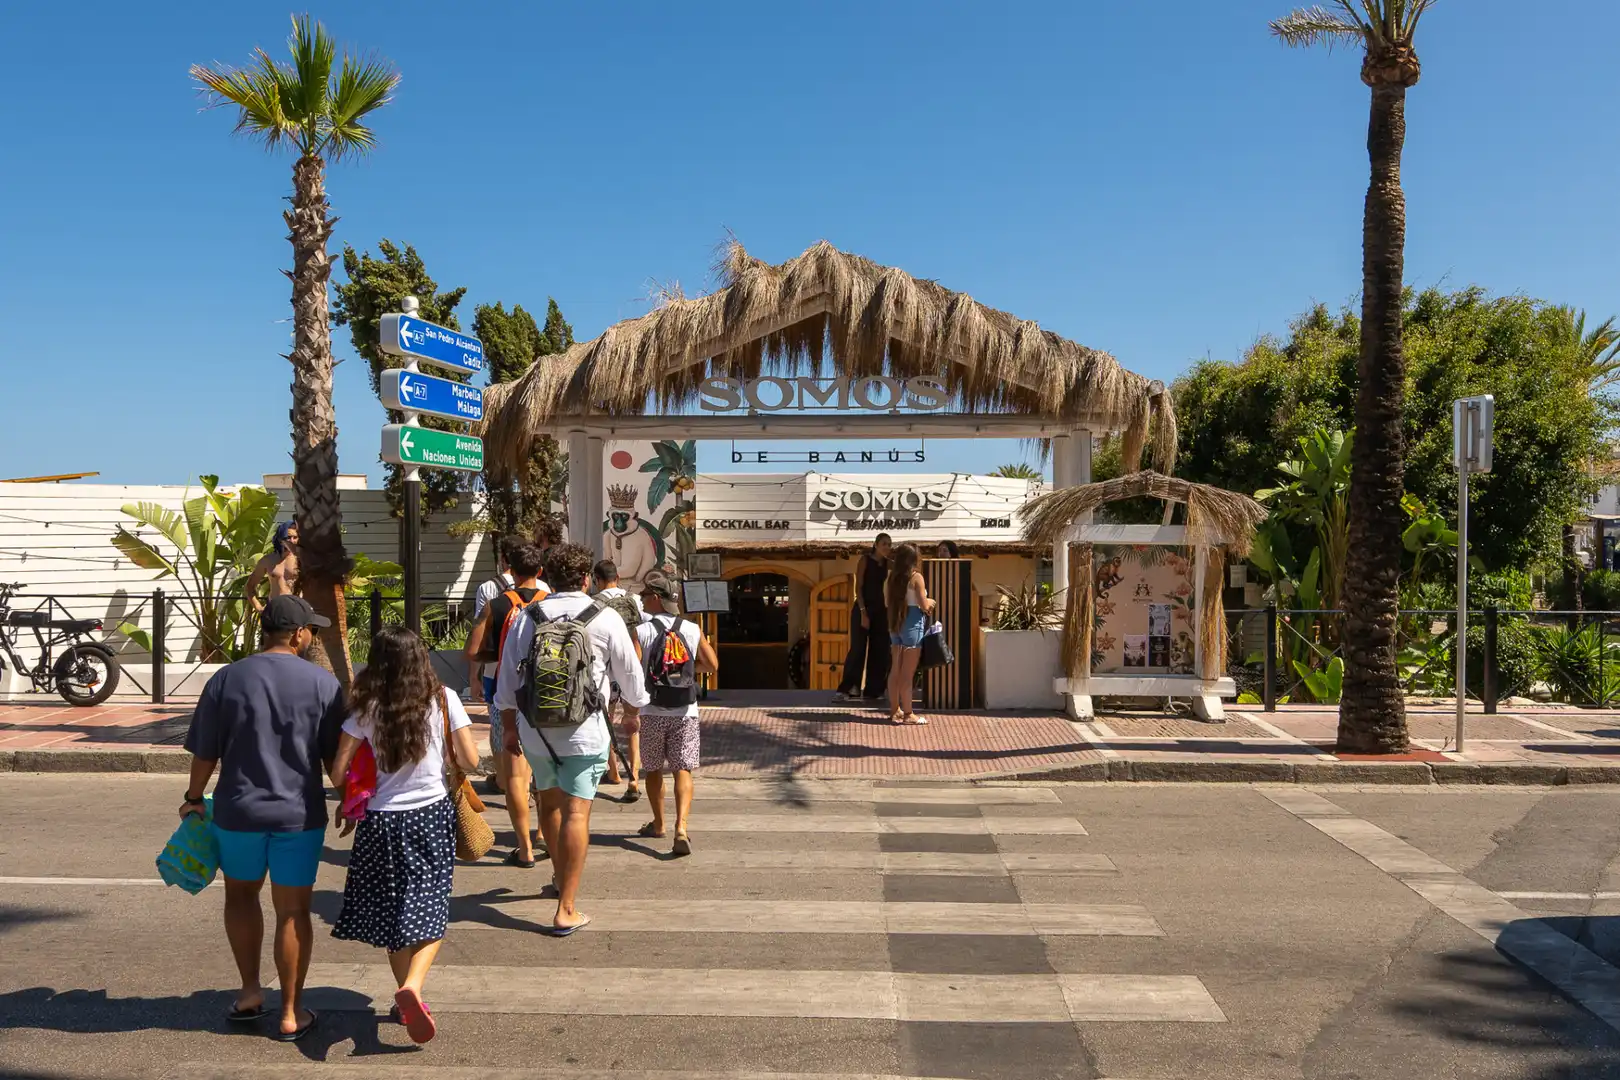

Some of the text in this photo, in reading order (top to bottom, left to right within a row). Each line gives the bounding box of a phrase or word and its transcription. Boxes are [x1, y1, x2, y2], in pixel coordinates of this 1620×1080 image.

[415, 333, 424, 343] A-7
[425, 327, 437, 339] San
[438, 332, 454, 345] Pedro
[463, 353, 481, 368] Cádiz
[415, 386, 426, 397] A-7
[452, 384, 481, 401] Marbella
[699, 374, 948, 415] SOMOS
[457, 400, 481, 416] Málaga
[456, 438, 482, 453] Avenida
[422, 448, 482, 467] Naciones Unidas
[732, 448, 926, 463] DE BANÚS
[818, 489, 947, 512] SOMOS
[702, 519, 790, 530] COCKTAIL BAR
[846, 519, 921, 531] RESTAURANTE
